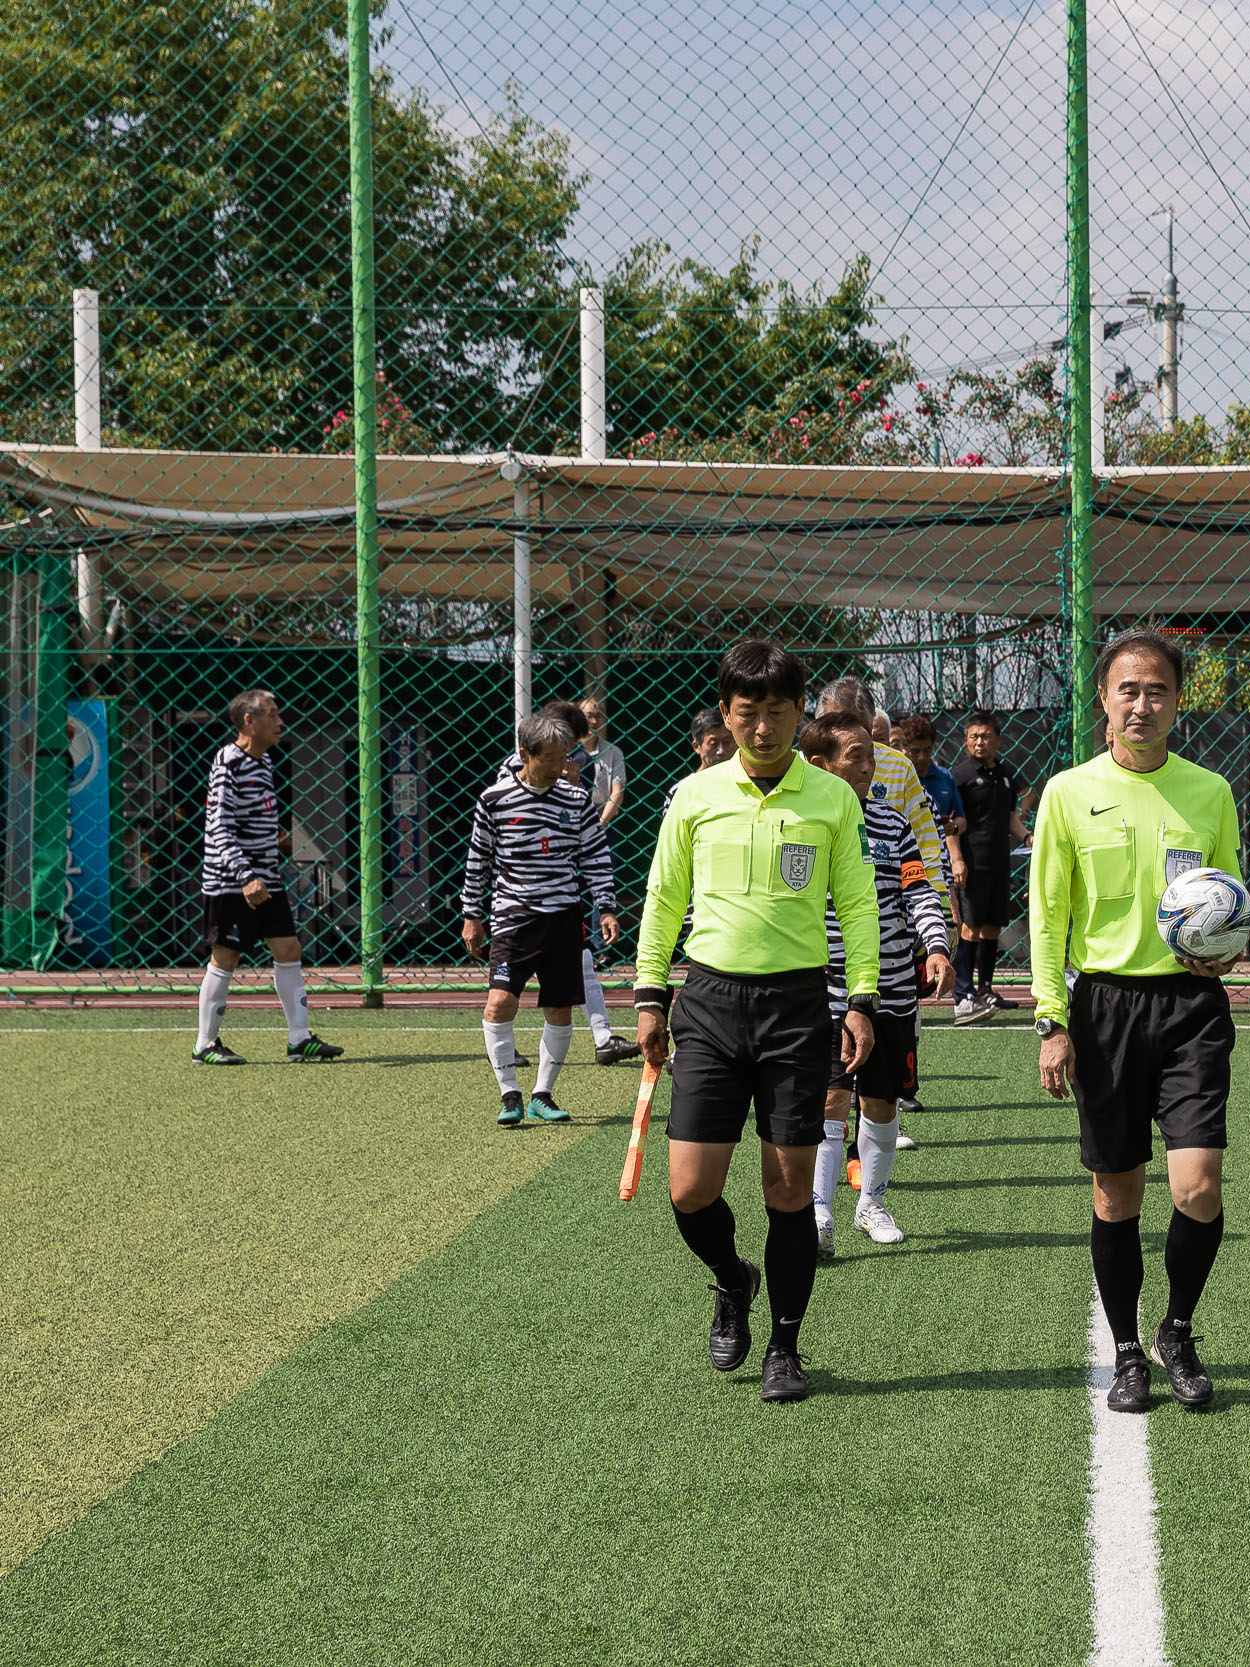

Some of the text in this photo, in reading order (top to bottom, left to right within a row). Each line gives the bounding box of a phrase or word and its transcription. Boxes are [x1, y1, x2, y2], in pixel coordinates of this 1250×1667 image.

[540, 836, 550, 854] 8
[783, 845, 817, 855] REFEREE
[1167, 850, 1202, 862] REFEREE
[906, 1051, 915, 1086] 9
[1117, 1341, 1141, 1352] SFA
